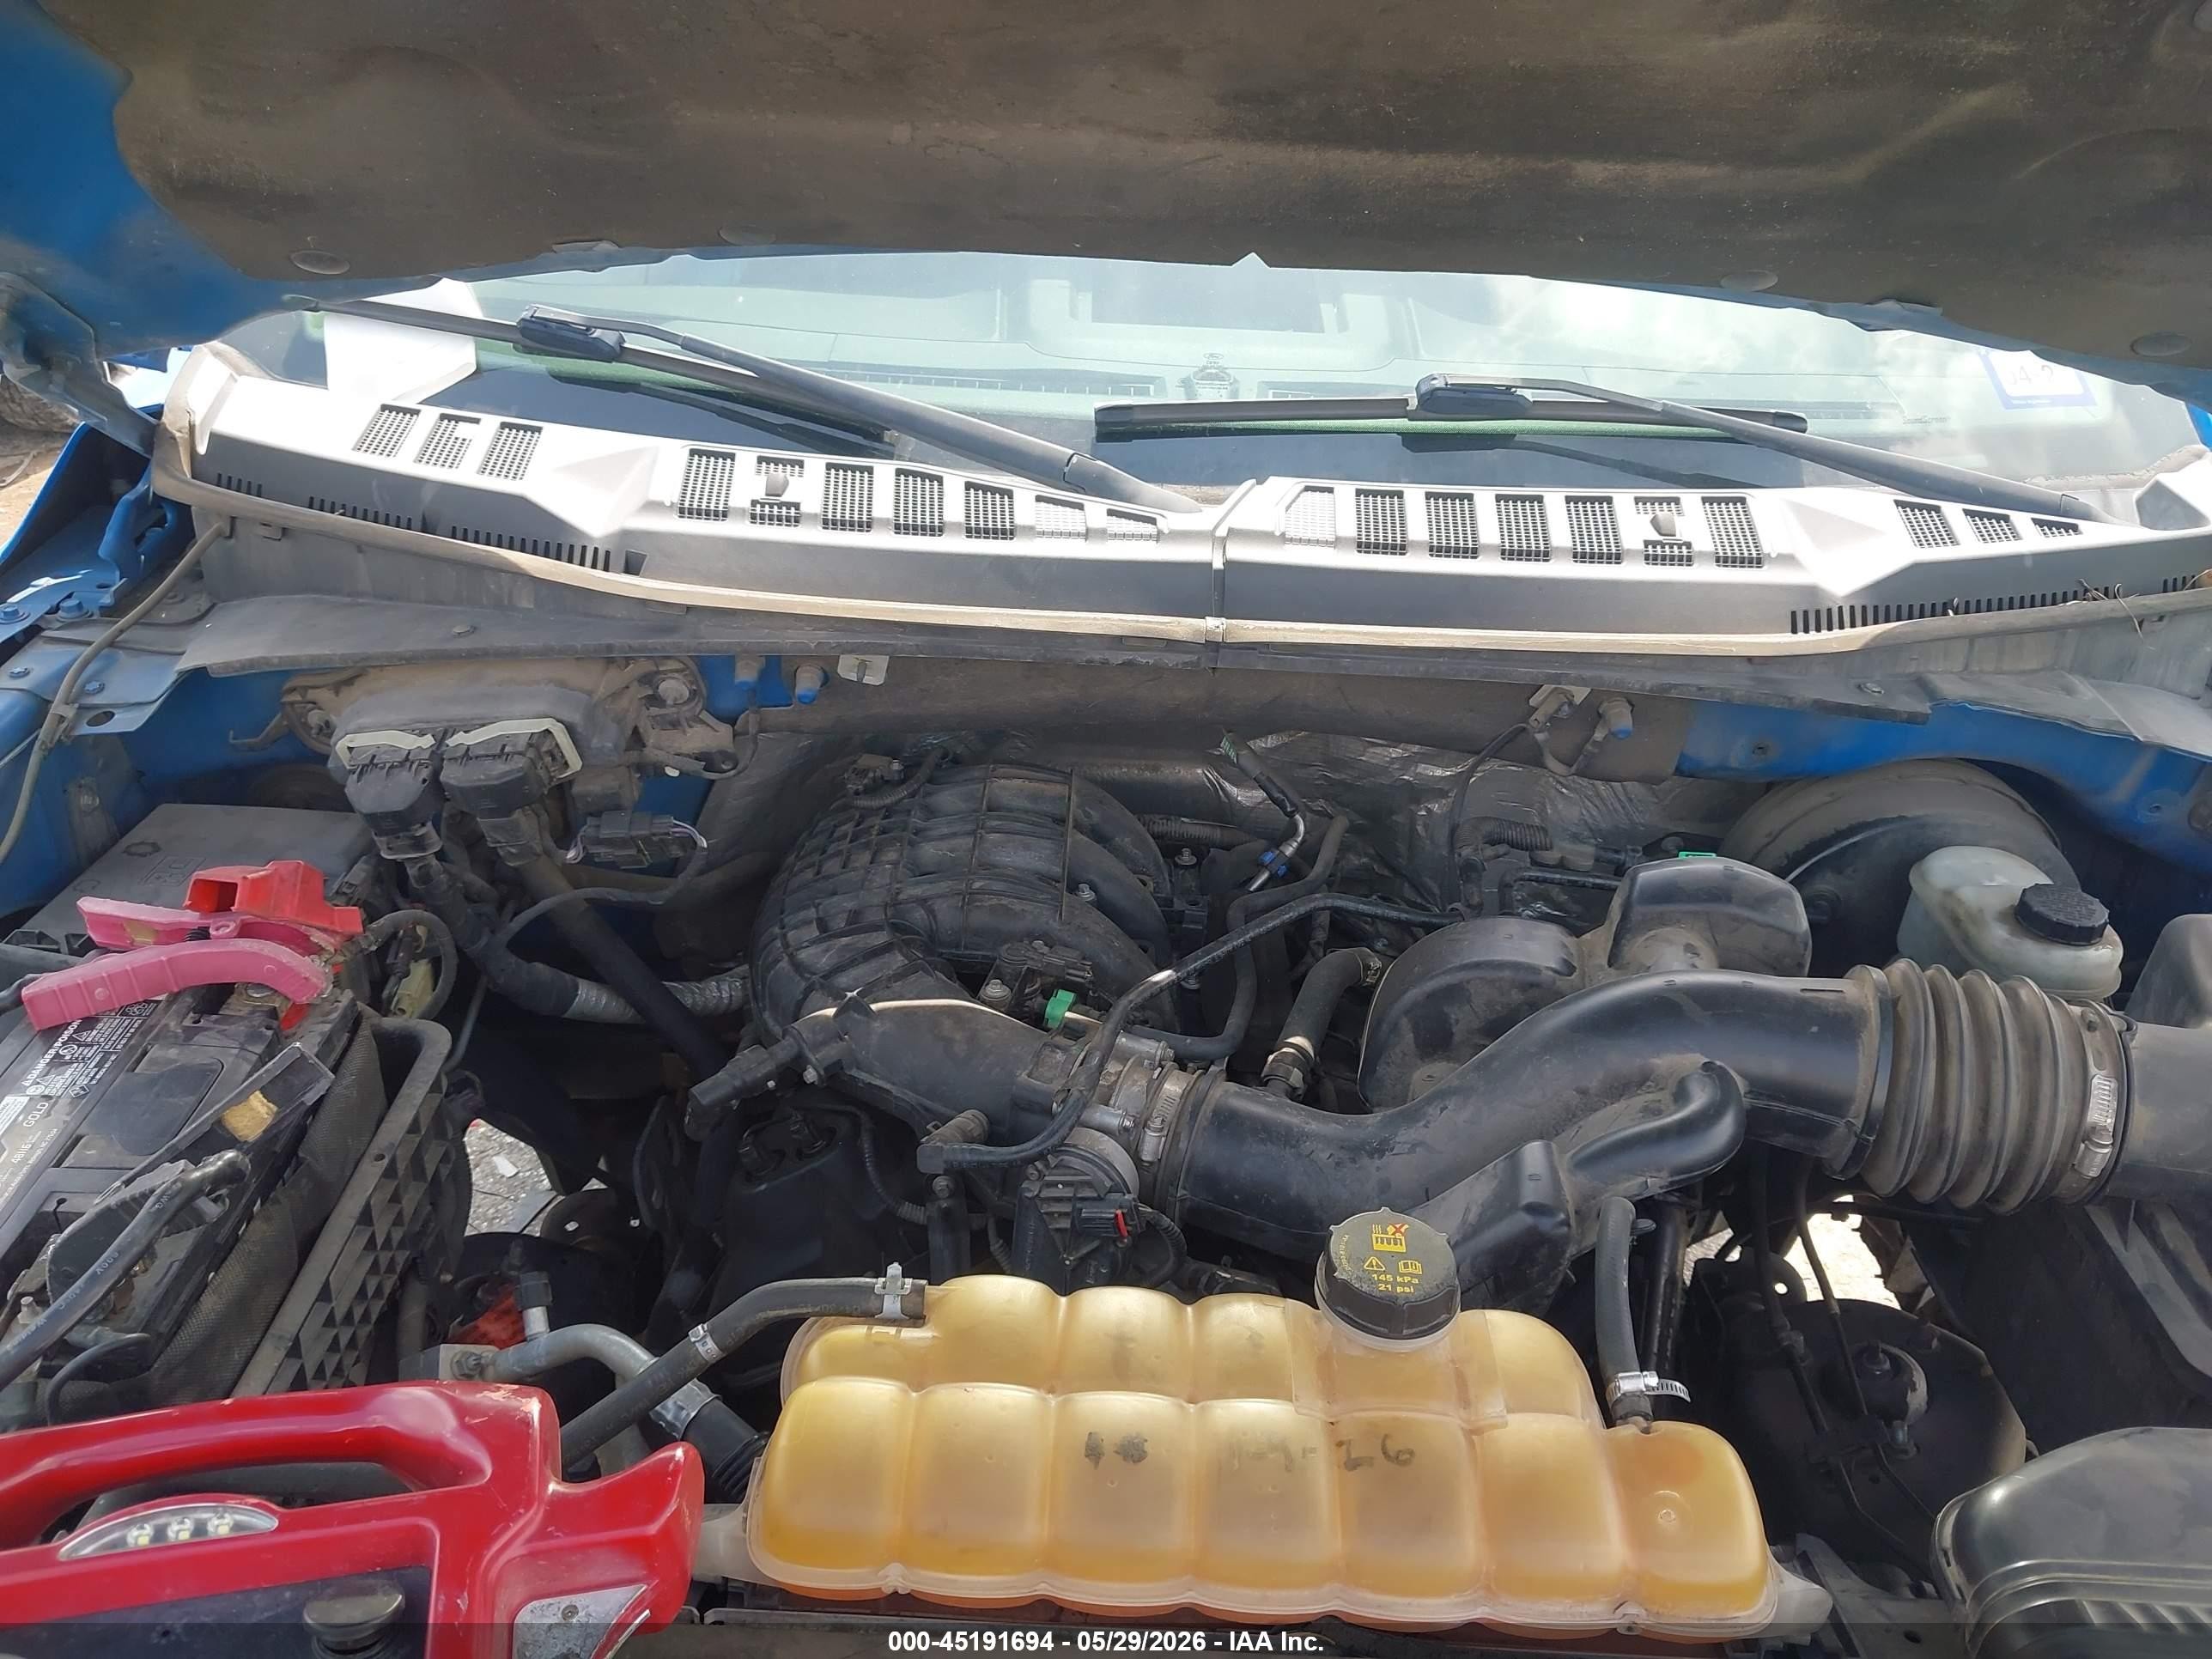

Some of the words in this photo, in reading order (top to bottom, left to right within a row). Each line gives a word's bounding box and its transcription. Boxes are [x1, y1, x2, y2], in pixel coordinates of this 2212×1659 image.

[23, 1102, 49, 1127] GOLD
[1372, 1273, 1393, 1283] 145
[1396, 1275, 1419, 1284] kPa
[1377, 1283, 1393, 1291] 21
[1396, 1285, 1415, 1294] psi
